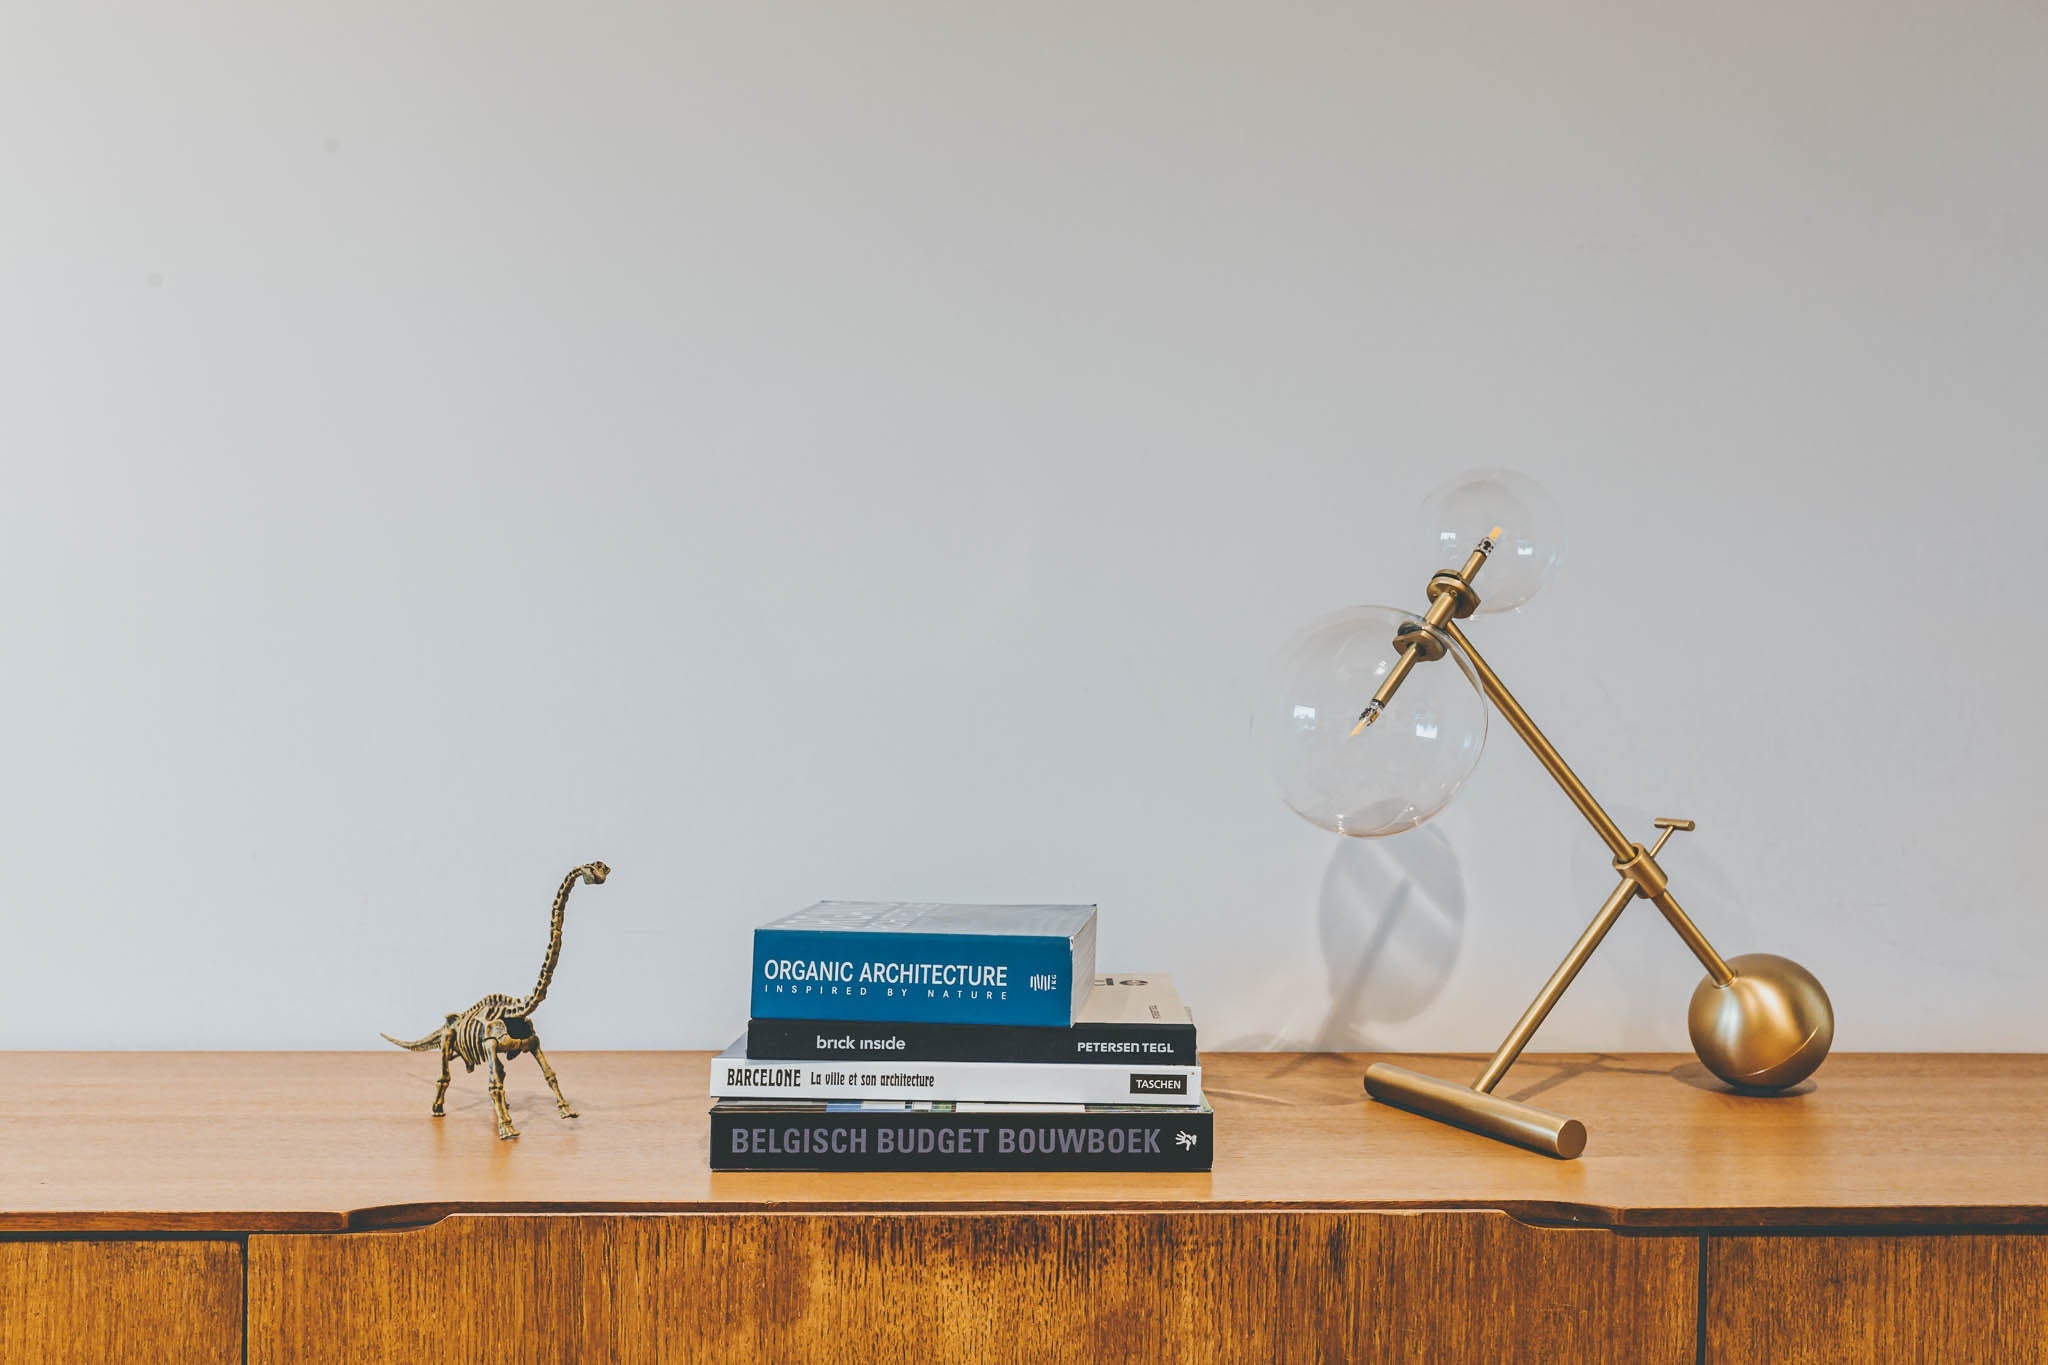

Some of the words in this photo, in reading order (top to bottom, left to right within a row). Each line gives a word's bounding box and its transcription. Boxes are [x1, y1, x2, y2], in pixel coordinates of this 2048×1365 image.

[764, 959, 854, 981] ORGANIC
[858, 962, 1008, 987] ARCHITECTURE
[764, 984, 867, 996] INSPIRED
[887, 988, 908, 997] BY
[927, 989, 1007, 1001] NATURE
[816, 1035, 855, 1050] brick
[859, 1035, 906, 1050] inside
[1077, 1042, 1140, 1053] PETERSEN
[1141, 1042, 1175, 1053] TEGL
[726, 1068, 801, 1087] BARCELONE
[810, 1071, 821, 1086] La
[825, 1071, 845, 1086] ville
[848, 1072, 858, 1087] et
[860, 1074, 877, 1087] son
[880, 1072, 935, 1088] architecture
[1135, 1079, 1181, 1090] TASCHEN
[731, 1127, 867, 1154] BELGISCH
[877, 1127, 990, 1154] BUDGET
[998, 1127, 1161, 1154] BOUWBOEK
